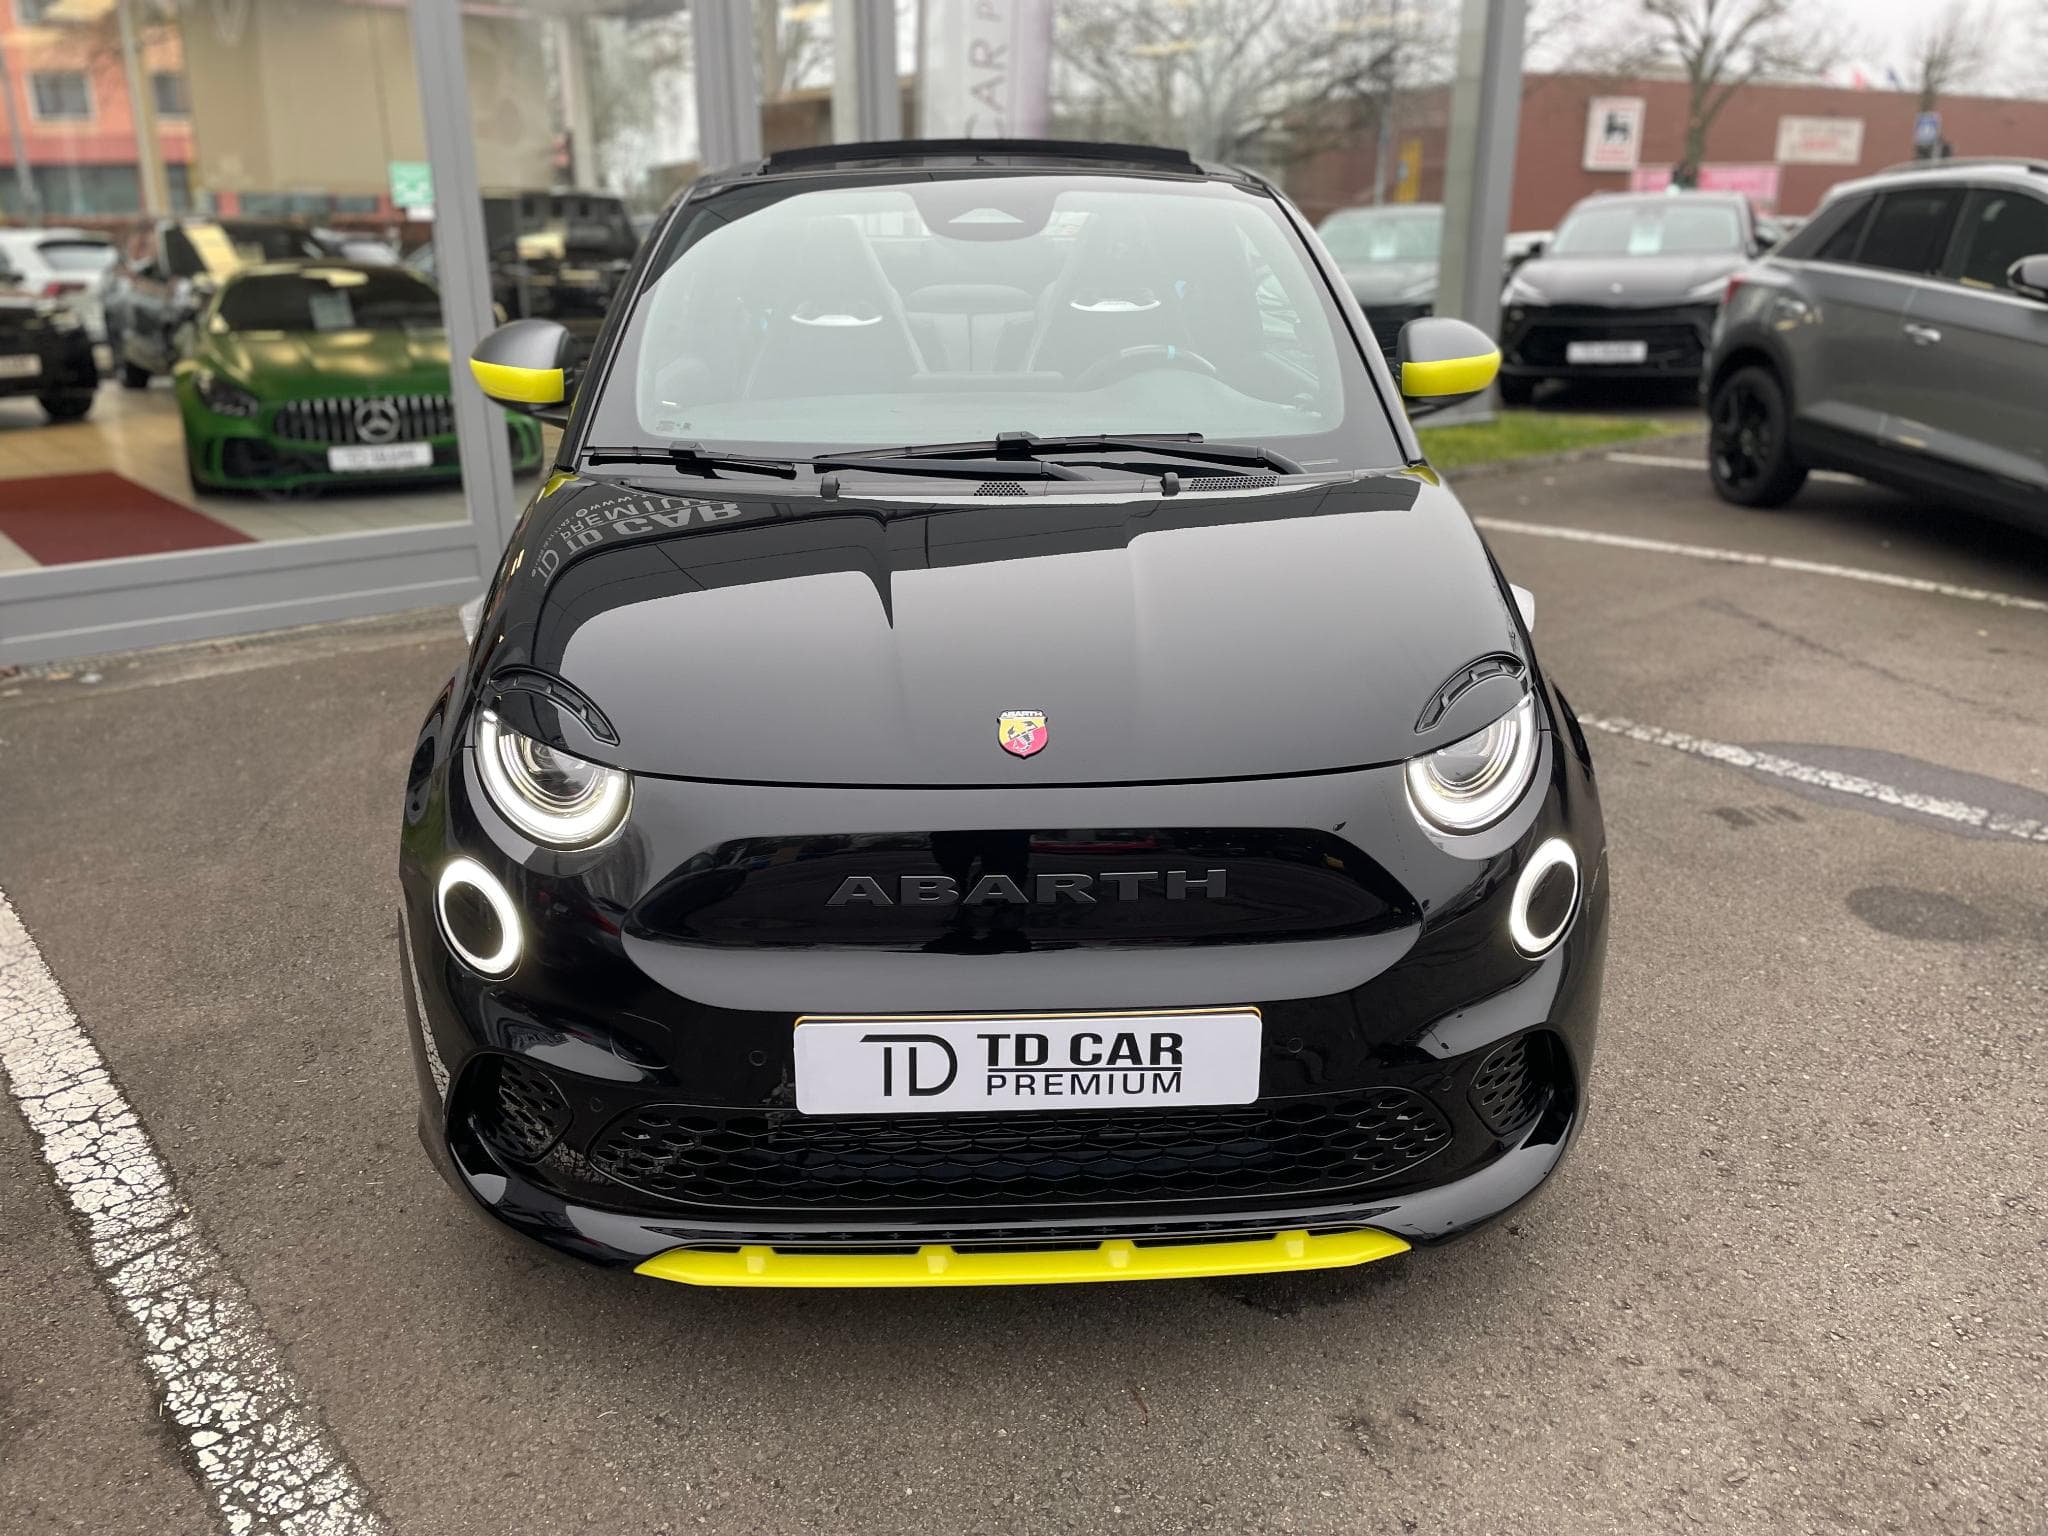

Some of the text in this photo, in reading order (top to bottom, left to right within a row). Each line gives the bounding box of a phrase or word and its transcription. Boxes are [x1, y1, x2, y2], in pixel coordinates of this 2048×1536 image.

[824, 868, 1228, 906] ABARTH
[977, 1032, 1183, 1067] TD CAR
[986, 1071, 1182, 1096] PREMIUM
